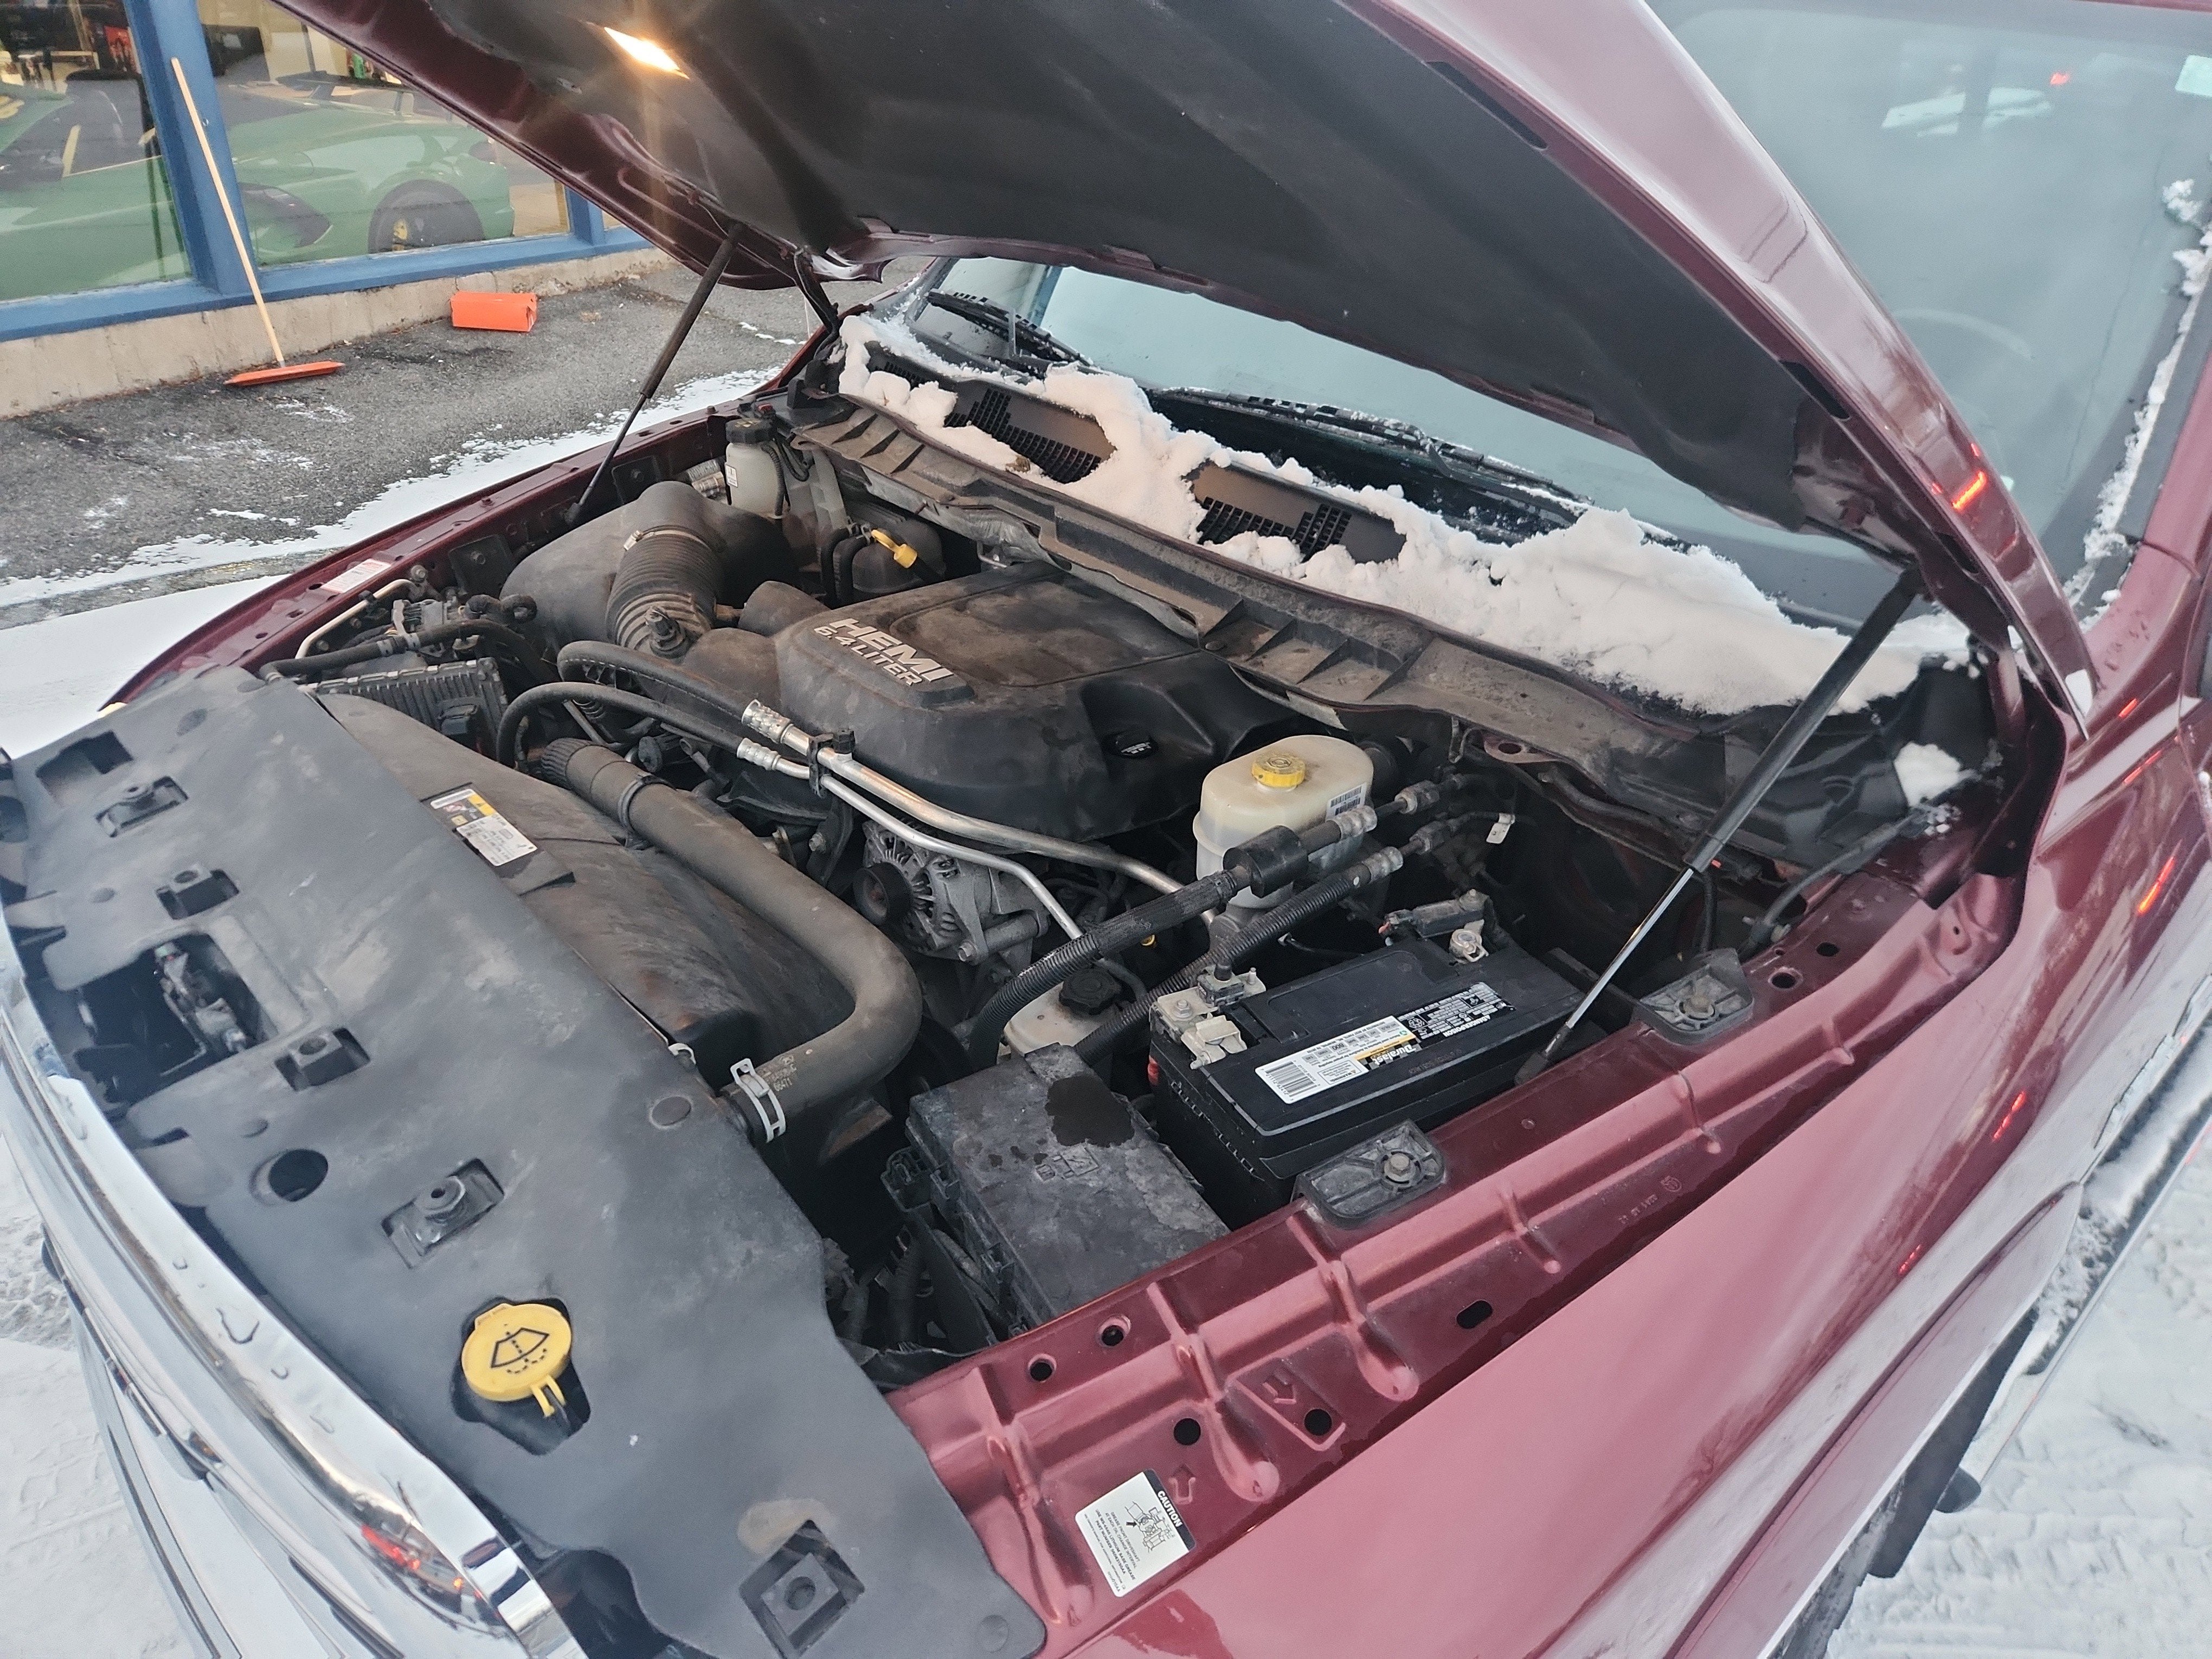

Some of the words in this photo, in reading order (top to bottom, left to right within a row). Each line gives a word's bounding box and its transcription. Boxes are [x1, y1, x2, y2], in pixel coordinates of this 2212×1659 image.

[814, 626, 857, 646] 6.4
[851, 645, 923, 686] LITER
[829, 618, 954, 682] HEMI
[1331, 1042, 1345, 1050] 800
[1371, 1043, 1417, 1066] Duralast
[1329, 1071, 1353, 1083] WARNING:
[1158, 1490, 1182, 1527] CAUTION
